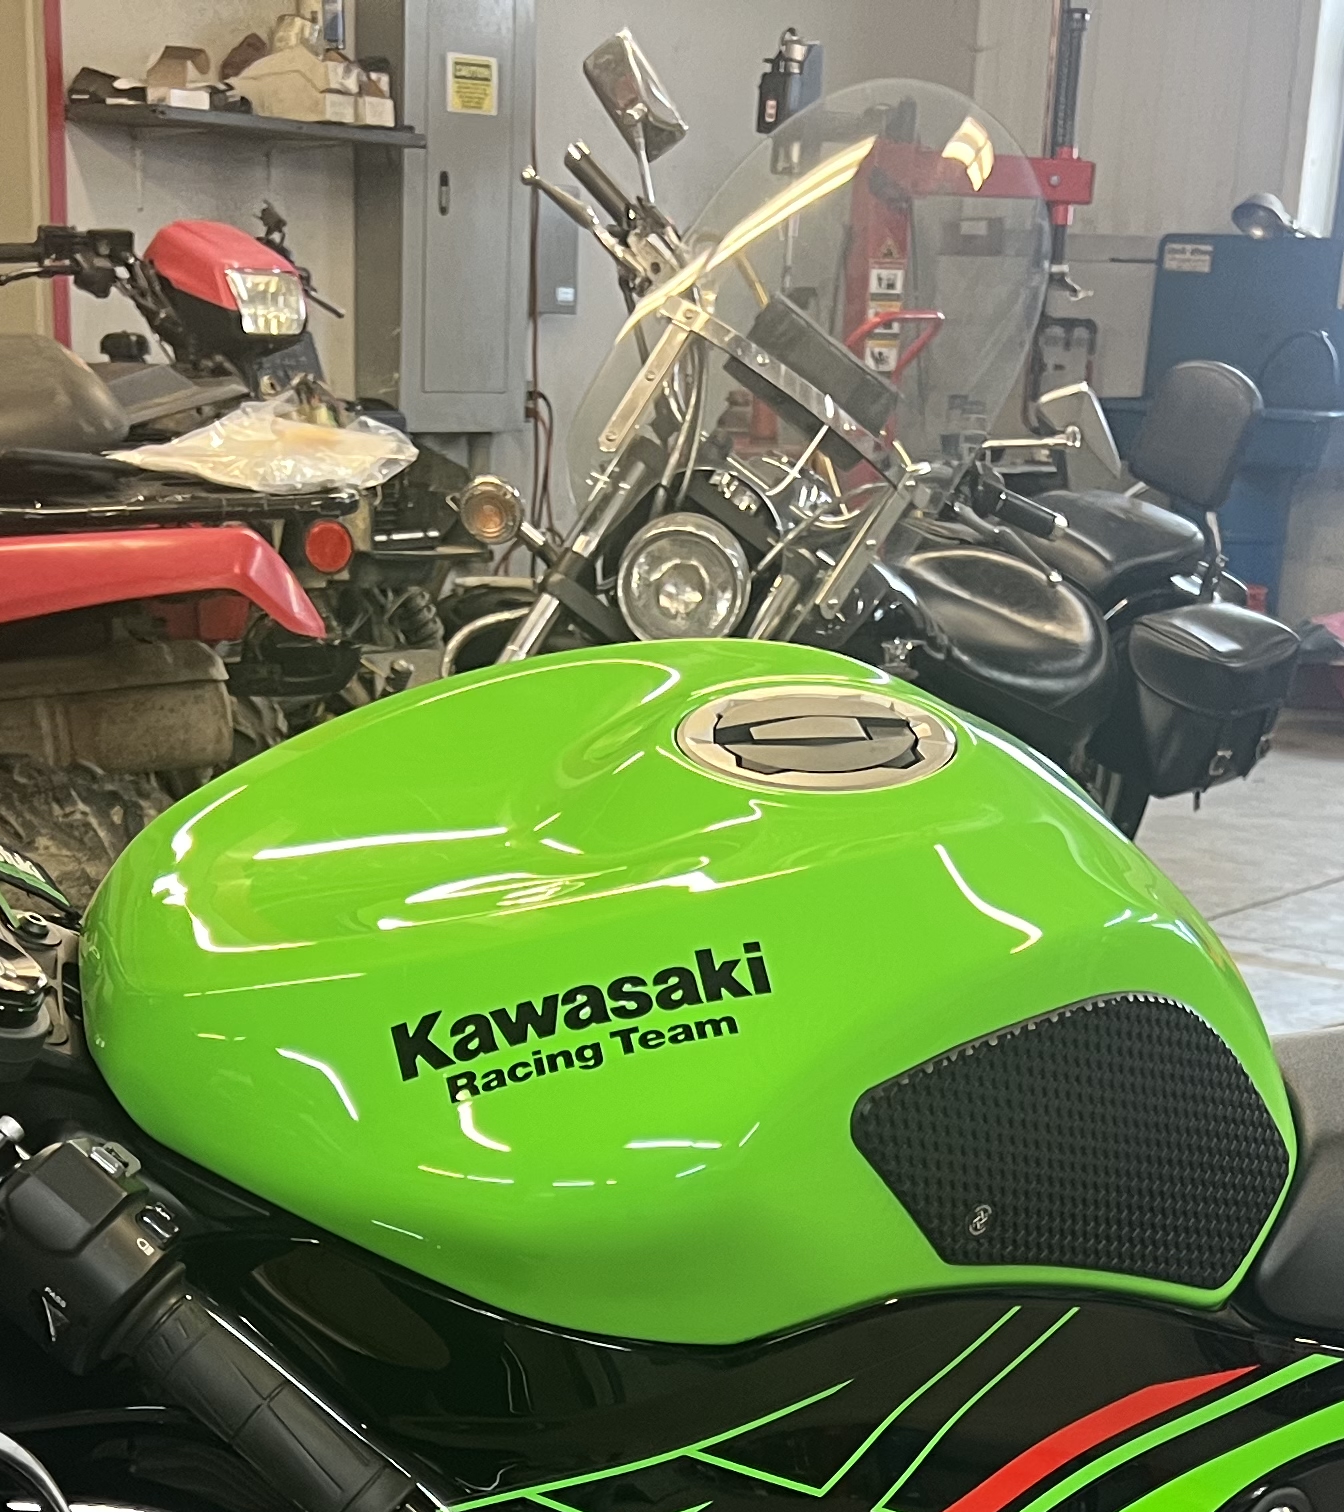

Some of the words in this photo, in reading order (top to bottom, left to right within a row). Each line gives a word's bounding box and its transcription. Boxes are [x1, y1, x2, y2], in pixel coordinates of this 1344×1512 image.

[389, 940, 772, 1082] Kawasaki
[445, 1041, 604, 1104] Racing
[609, 1015, 740, 1057] Team
